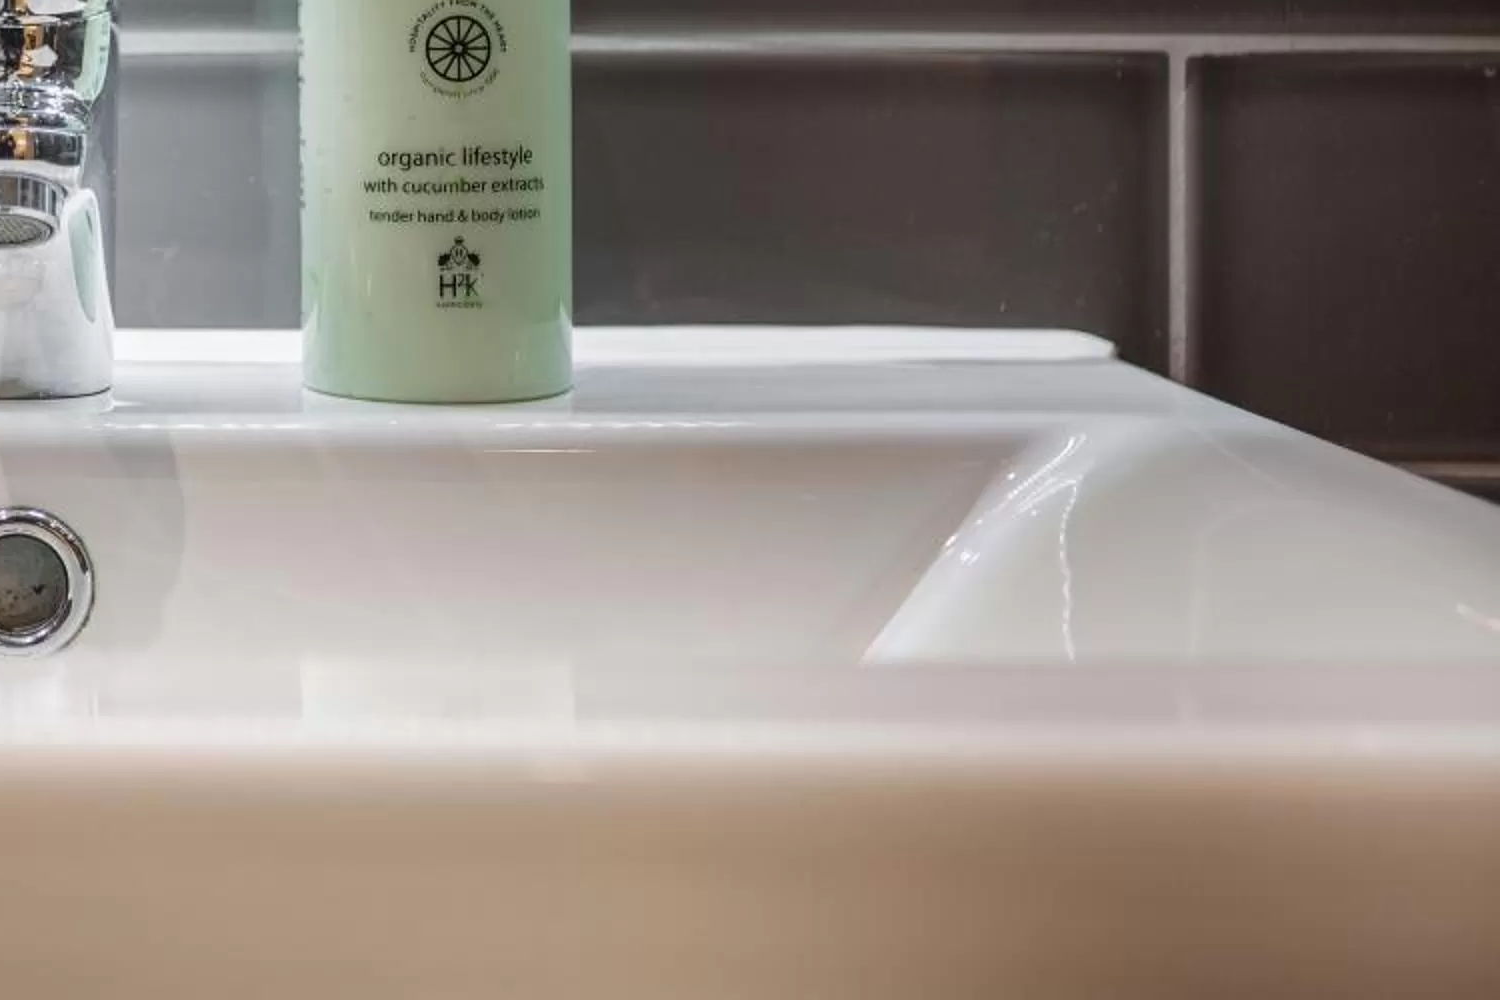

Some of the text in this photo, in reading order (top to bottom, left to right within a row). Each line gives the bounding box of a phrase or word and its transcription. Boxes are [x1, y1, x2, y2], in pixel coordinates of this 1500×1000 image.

[377, 145, 533, 172] organic lifestyle
[363, 176, 545, 195] with cucumber extracts
[369, 207, 541, 224] tender hand & body lotion
